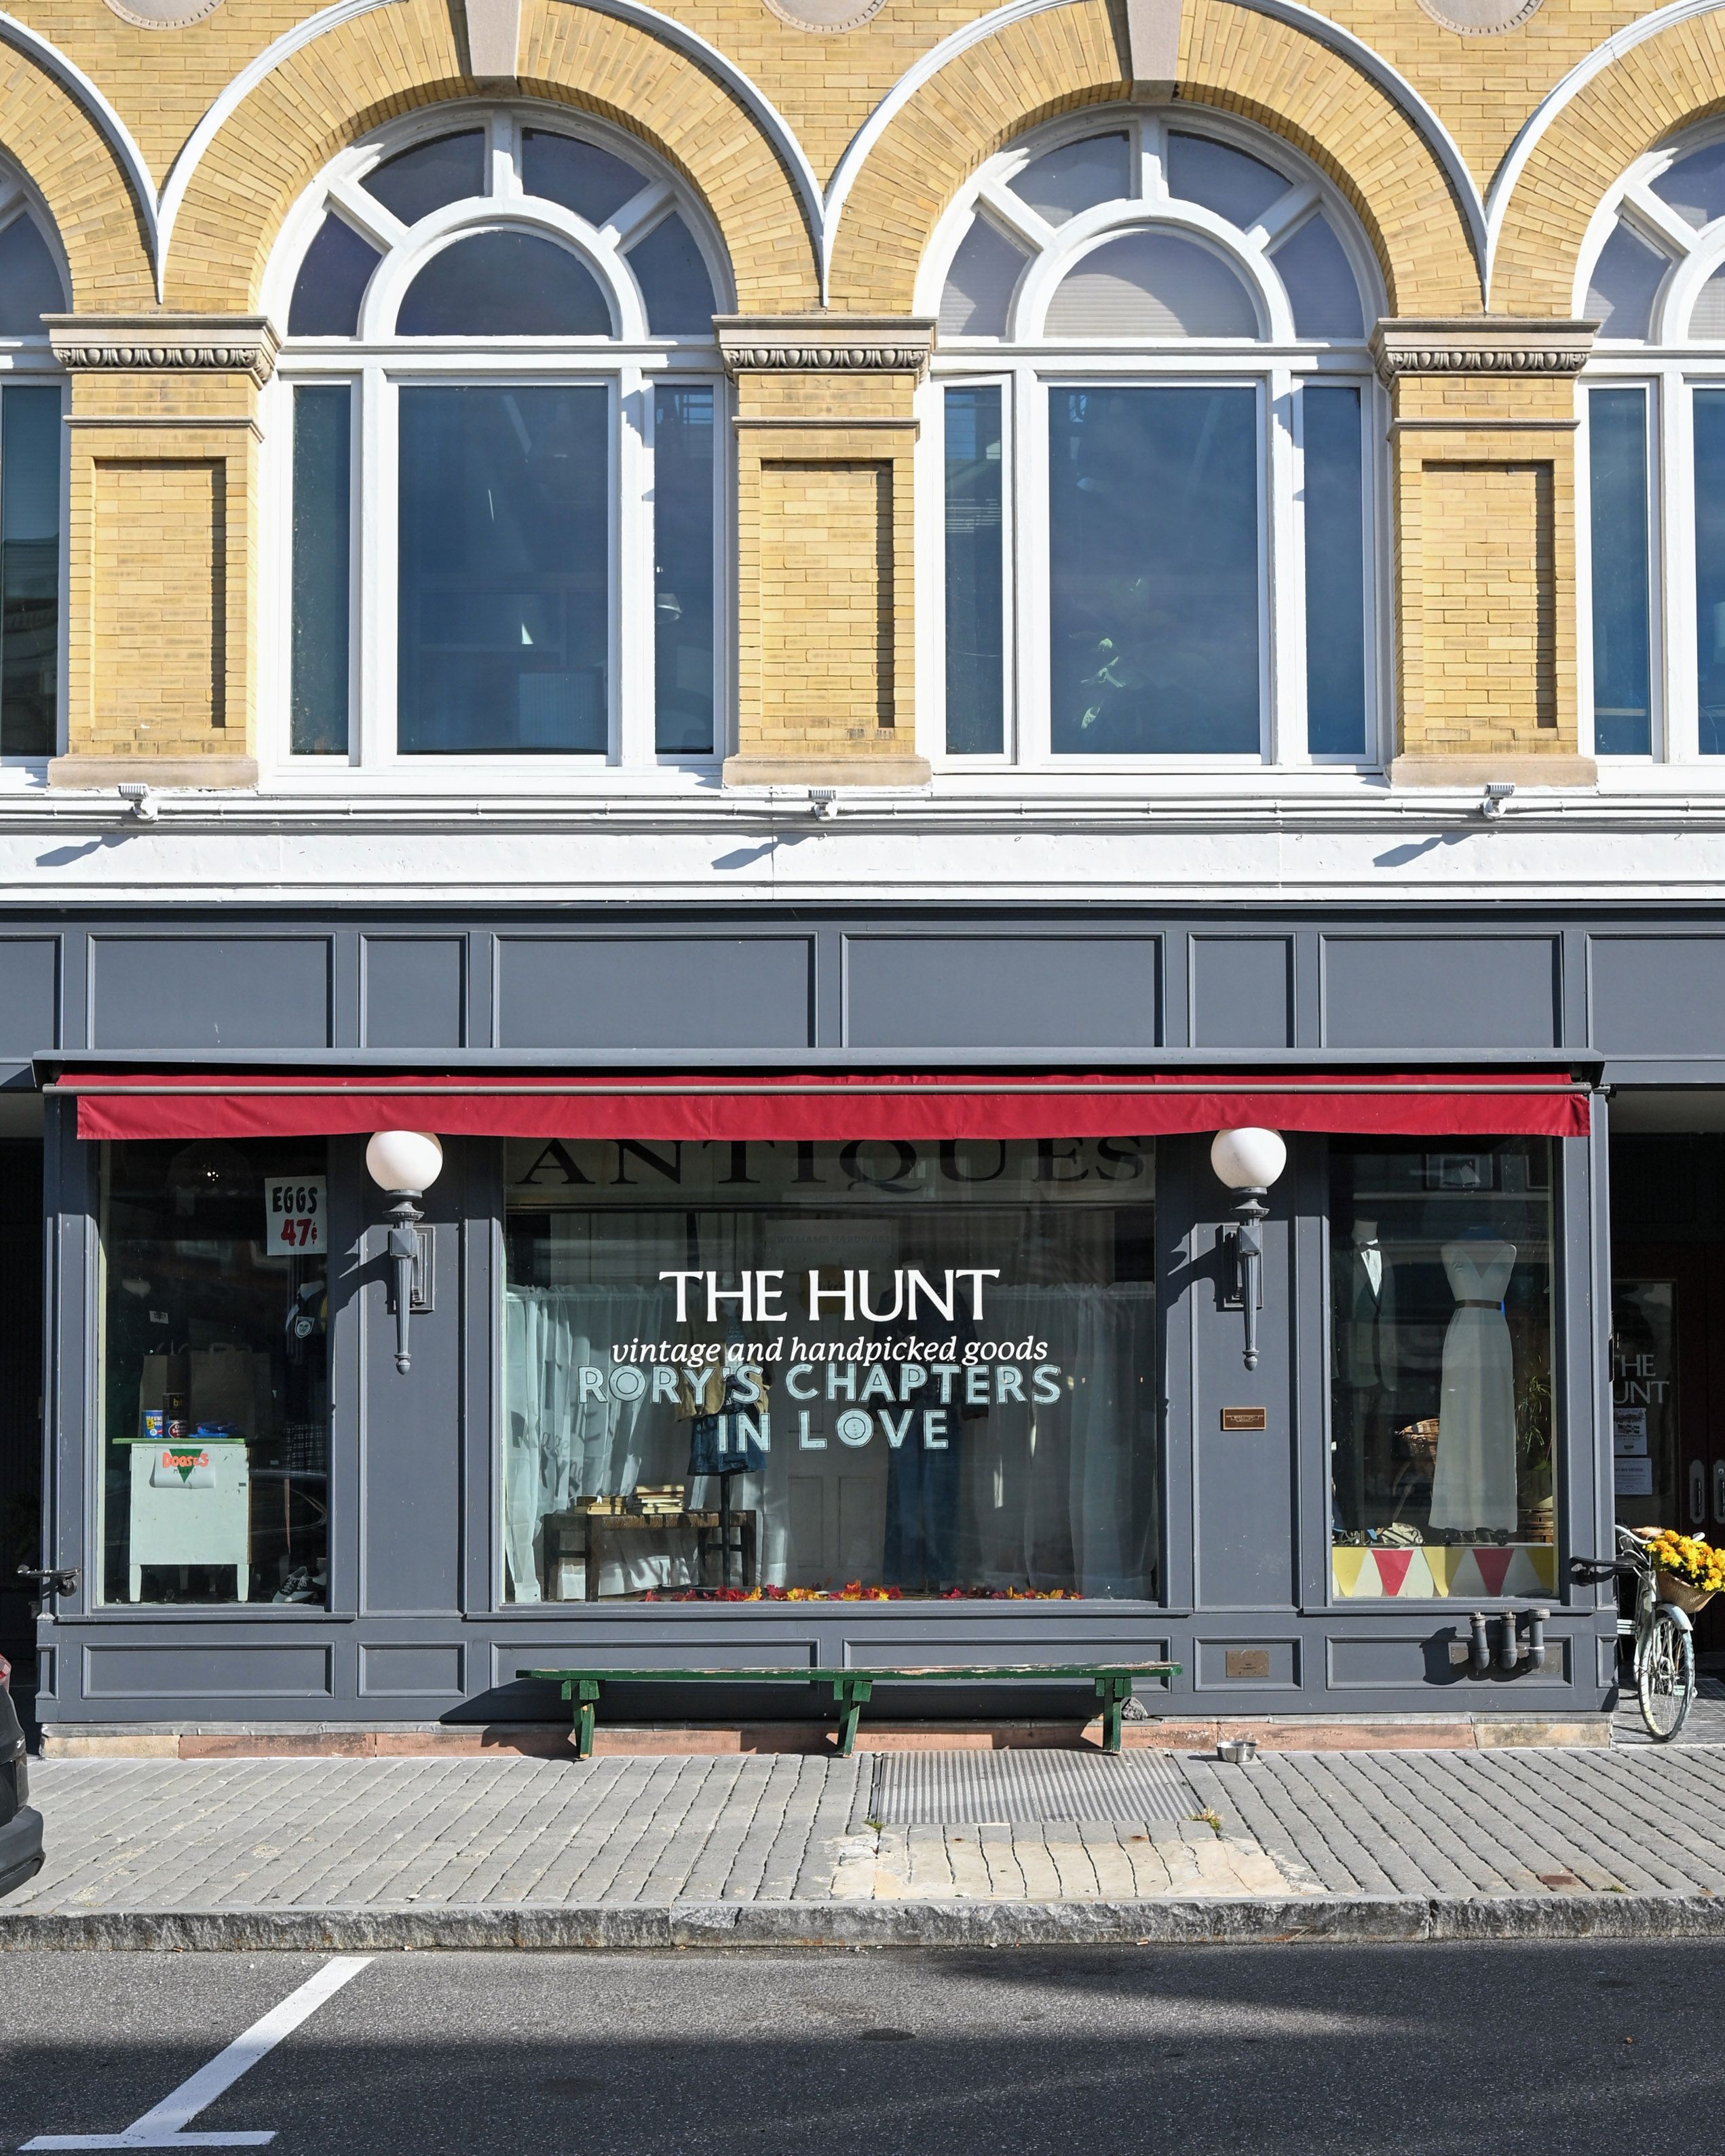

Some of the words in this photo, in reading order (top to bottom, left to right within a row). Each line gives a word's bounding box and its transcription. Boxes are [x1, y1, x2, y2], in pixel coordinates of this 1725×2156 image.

[514, 1137, 1145, 1192] ANTIQUES
[272, 1186, 318, 1214] EGGS
[659, 1270, 788, 1322] THE
[809, 1269, 1001, 1322] HUNT
[612, 1338, 721, 1367] vintage
[727, 1336, 782, 1362] and
[790, 1336, 957, 1367] handpicked
[961, 1335, 1048, 1366] goods
[578, 1364, 764, 1406] RORY'S
[785, 1362, 1062, 1405] CHAPTERS
[1614, 1381, 1670, 1404] UNT
[717, 1412, 771, 1454] IN
[799, 1408, 949, 1450] LOVE
